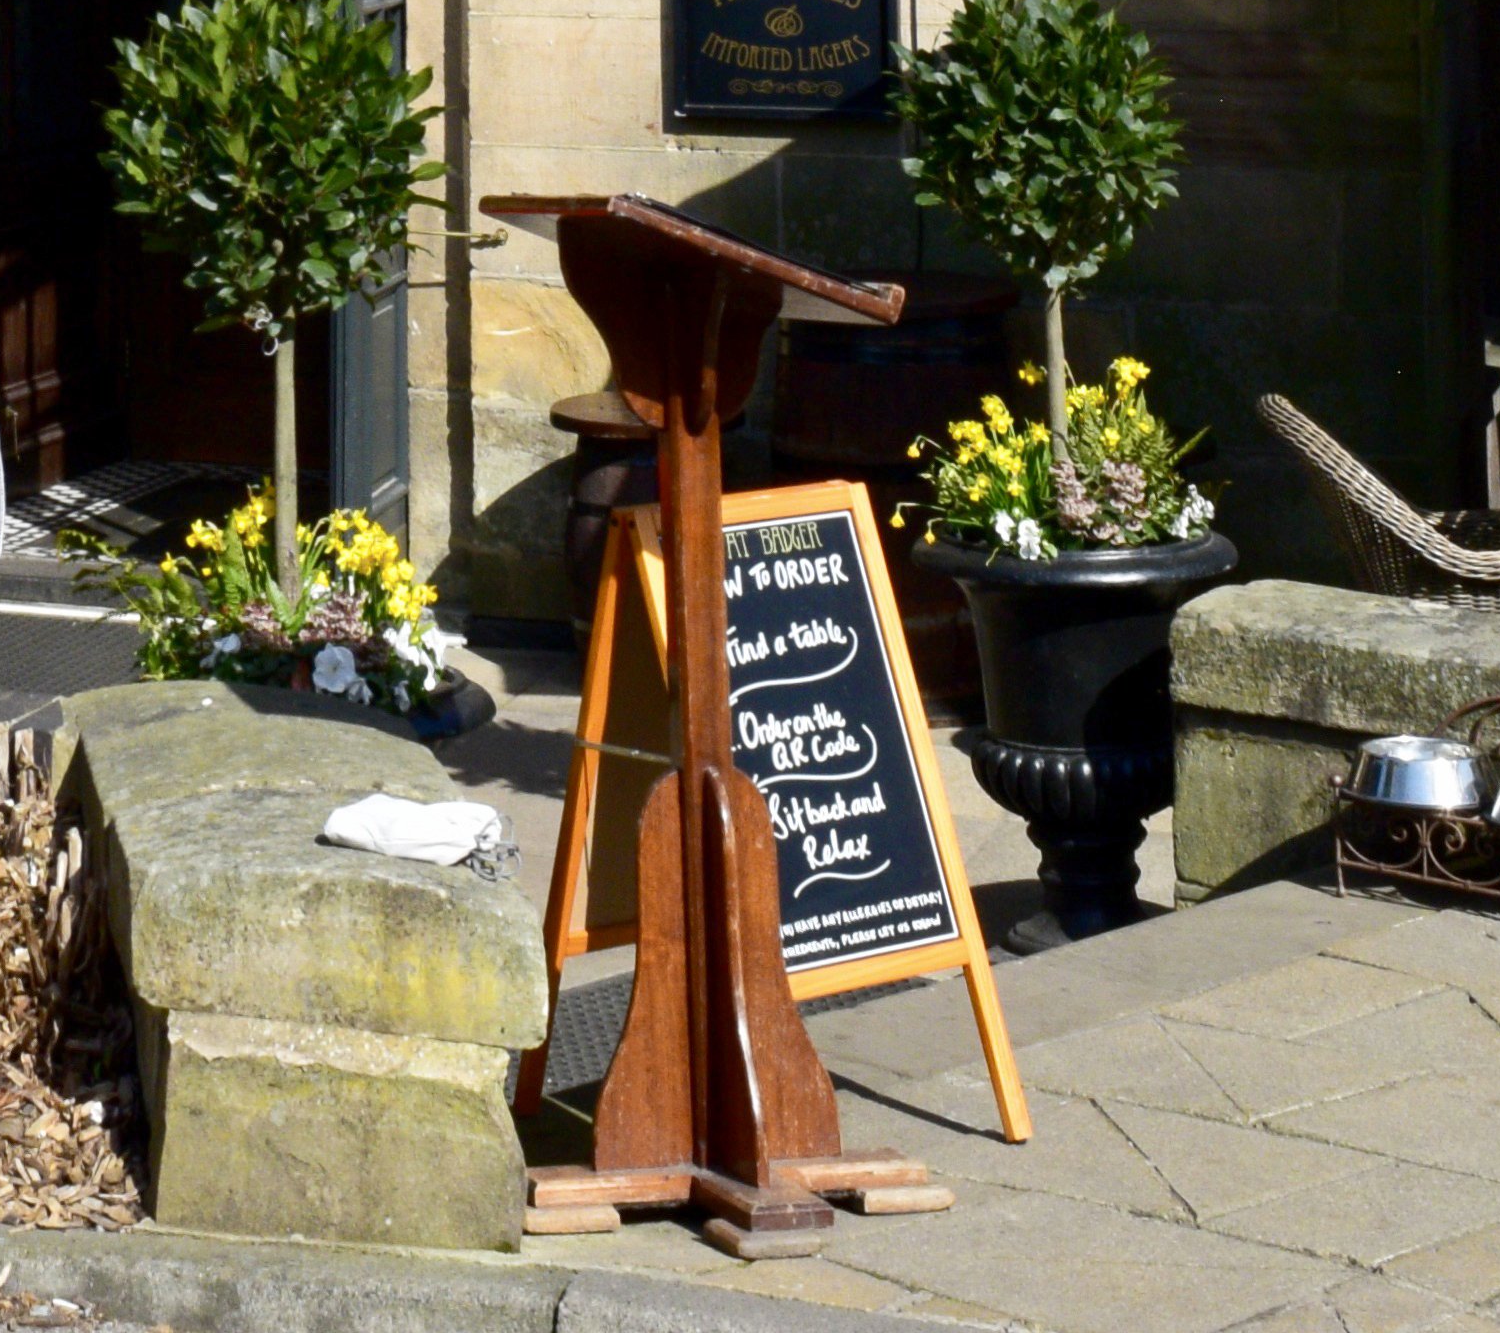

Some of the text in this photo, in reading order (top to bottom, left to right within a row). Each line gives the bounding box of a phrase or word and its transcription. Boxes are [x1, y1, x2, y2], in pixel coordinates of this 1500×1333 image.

[701, 32, 871, 72] IMPORTED LAGERS
[725, 521, 824, 560] AT BADGER
[773, 553, 850, 590] ORDER
[774, 635, 788, 657] a
[788, 617, 848, 650] table
[792, 715, 816, 735] on
[813, 702, 846, 731] the
[771, 730, 861, 771] QR Code
[769, 781, 887, 840] Sit back and
[802, 828, 872, 870] Relax
[794, 915, 821, 934] HAVE
[893, 897, 905, 912] OR
[841, 927, 877, 947] PLEASE
[897, 921, 911, 934] US
